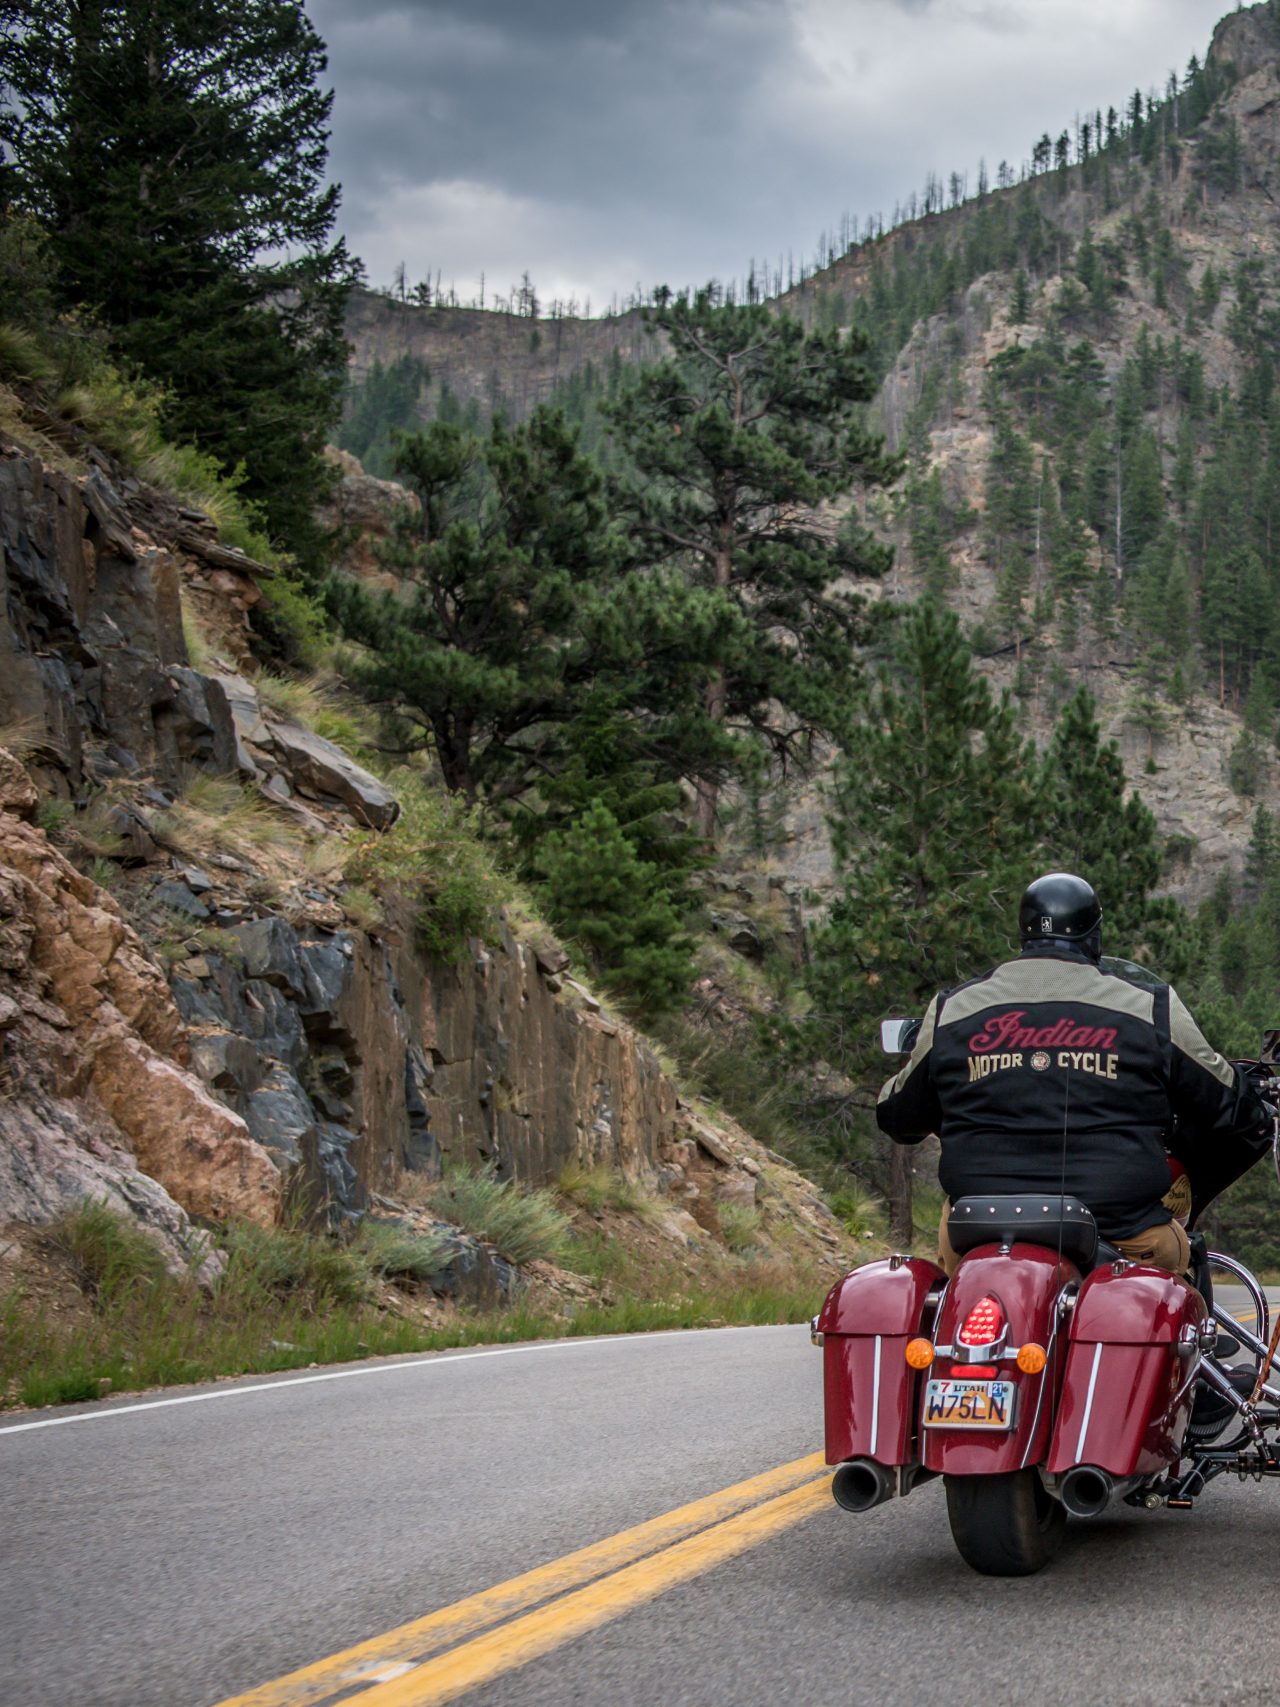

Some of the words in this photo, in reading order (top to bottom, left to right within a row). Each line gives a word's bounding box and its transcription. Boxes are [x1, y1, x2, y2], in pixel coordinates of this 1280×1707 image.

[968, 1010, 1118, 1053] Indian
[967, 1053, 1023, 1082] MOTOR
[1057, 1051, 1119, 1080] CYCLE
[941, 1382, 951, 1393] 7
[953, 1384, 984, 1393] UTAH
[993, 1383, 1003, 1394] 21
[928, 1395, 1005, 1422] W75LN
